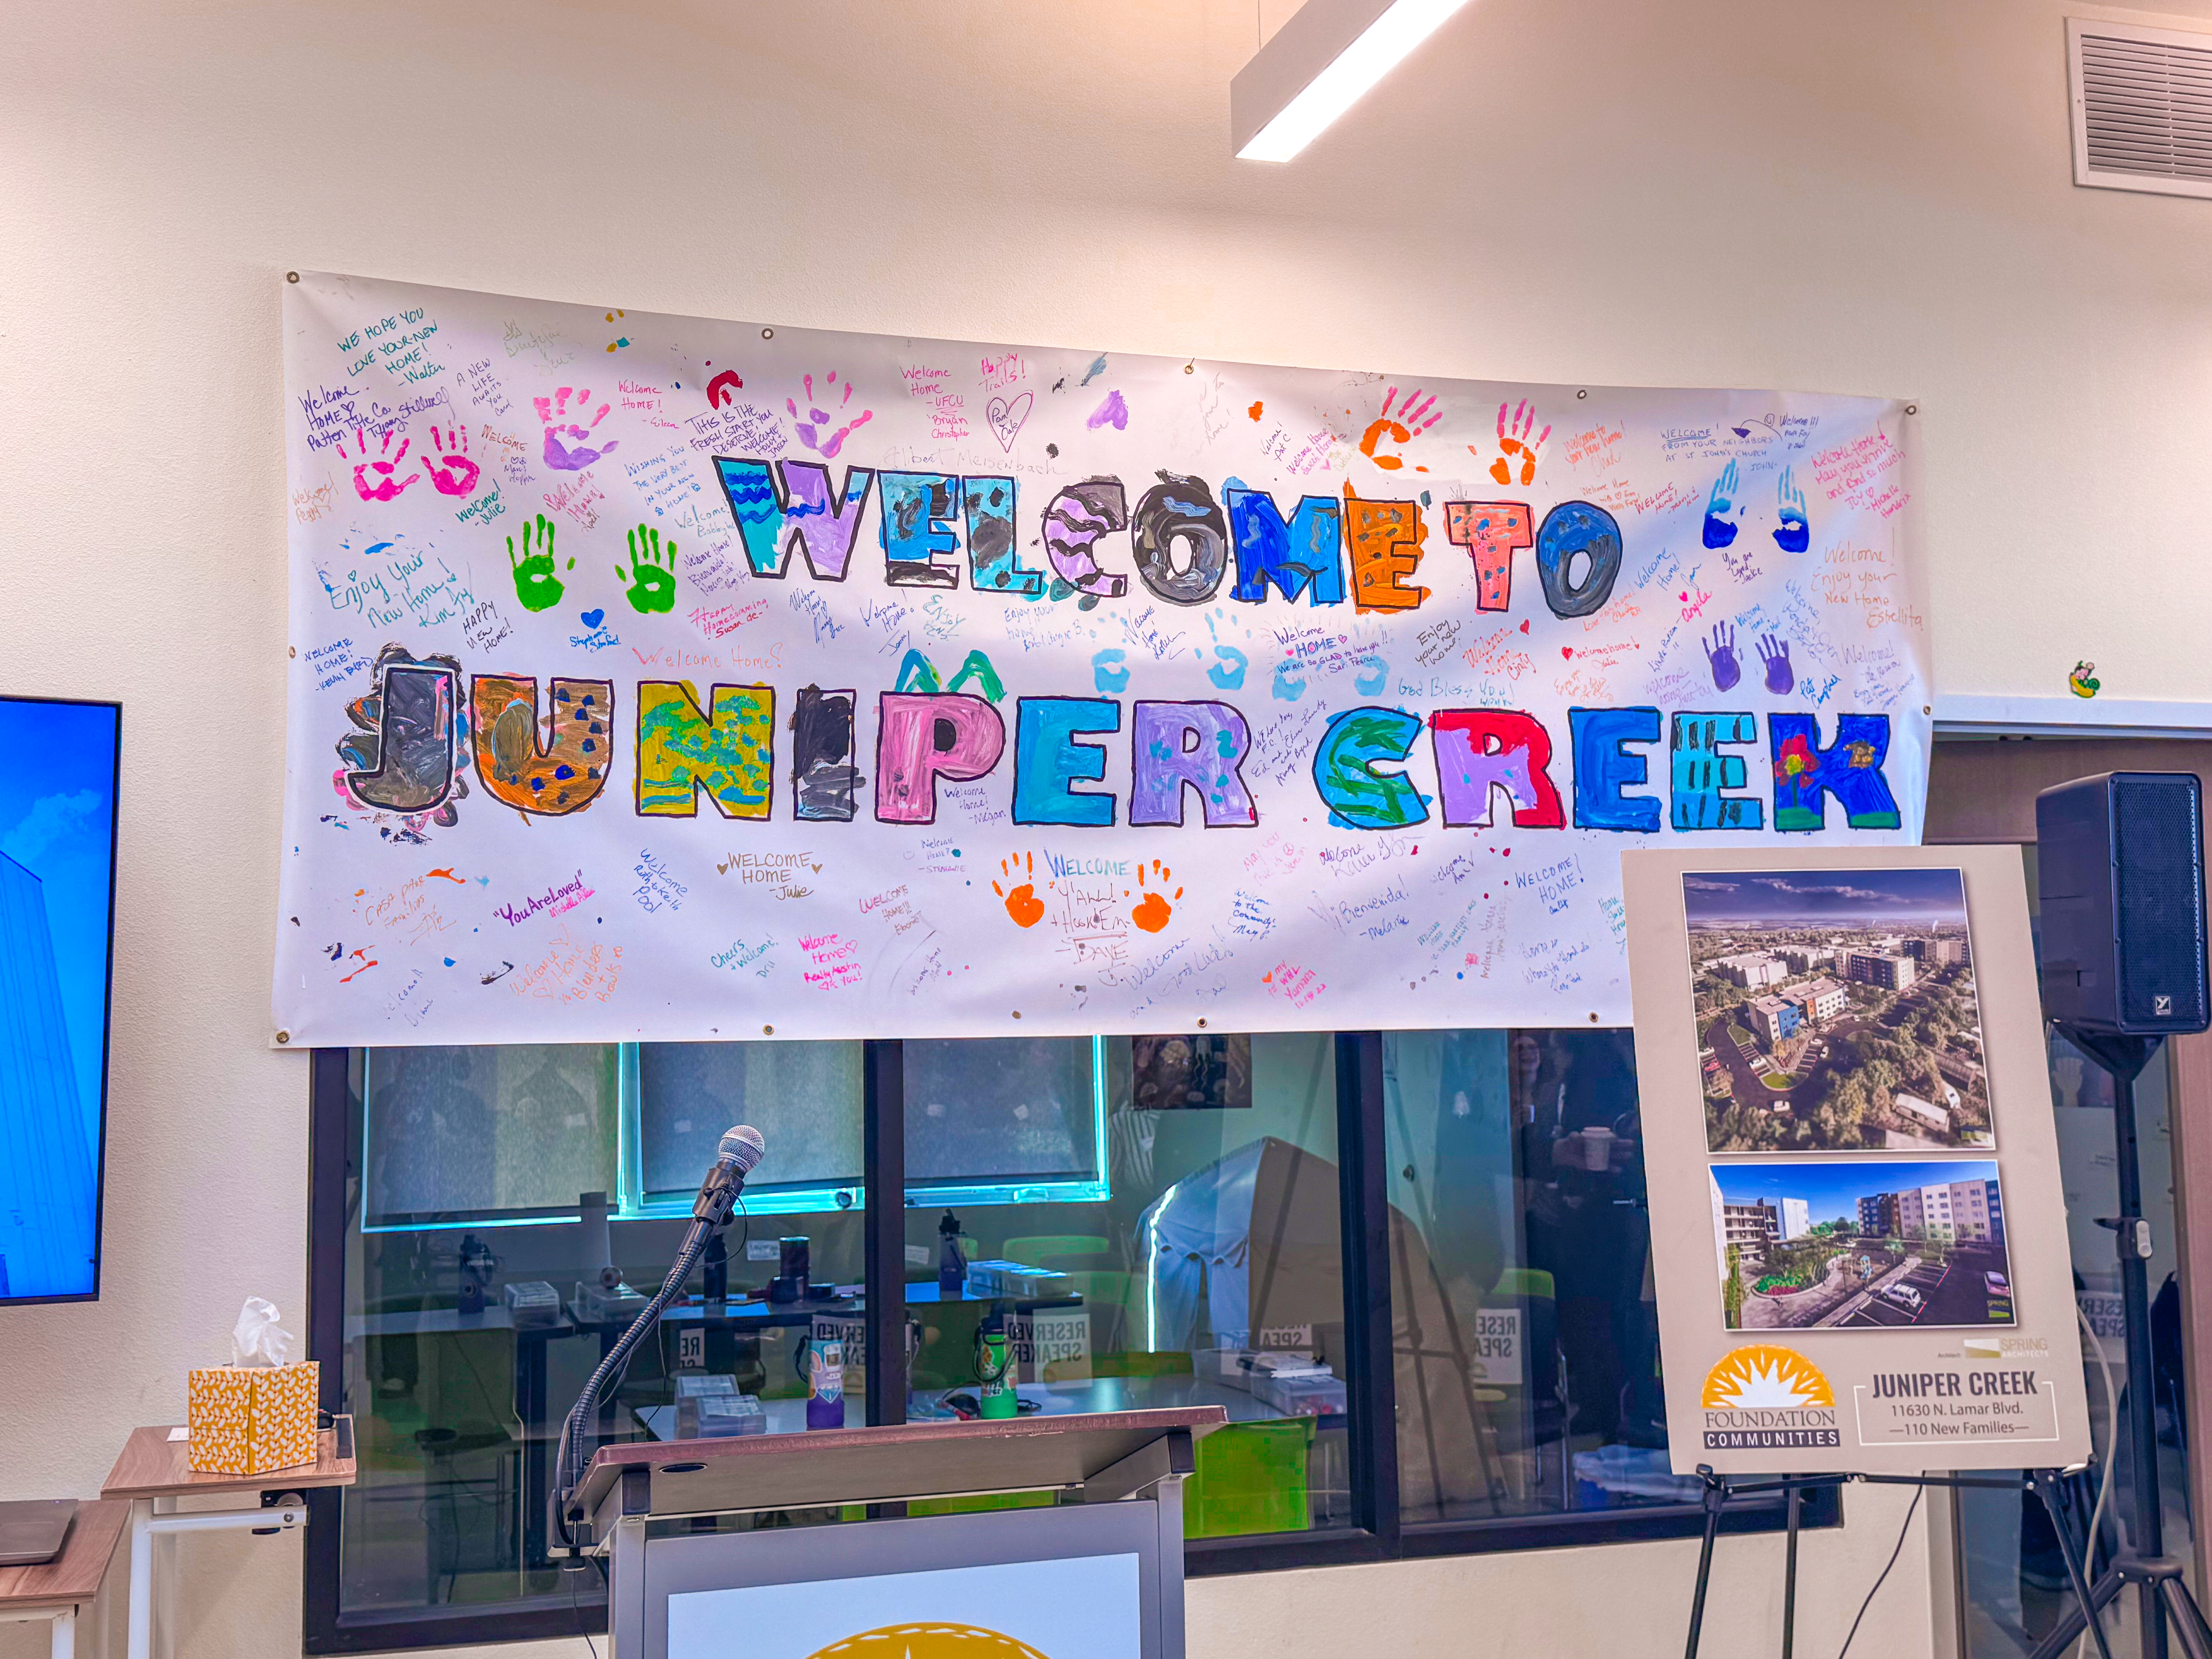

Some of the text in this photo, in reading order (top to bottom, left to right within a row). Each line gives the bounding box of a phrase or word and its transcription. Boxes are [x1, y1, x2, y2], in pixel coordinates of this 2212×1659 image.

[337, 307, 424, 352] WE HOPE YOU
[347, 350, 376, 376] LOVE
[385, 343, 432, 374] HOME!
[981, 353, 1018, 379] Happy
[457, 358, 491, 386] A NEW
[472, 373, 495, 392] LIFE
[900, 364, 951, 379] Welcome
[298, 385, 360, 413] Welcome
[472, 381, 501, 406] AWAITS
[619, 379, 662, 394] Welcome
[911, 383, 943, 396] Home
[485, 393, 503, 408] YOU
[621, 398, 663, 414] HOME!
[685, 404, 759, 435] THIS IS THE
[690, 410, 773, 451] FRESH START YOU
[932, 414, 967, 430] Bryan
[481, 424, 527, 451] WELCOME
[713, 426, 759, 455] DESERVE!
[741, 418, 785, 452] WELCOME!
[1662, 440, 1716, 452] FROM YOUR
[625, 454, 666, 477] WISHING
[882, 446, 955, 469] Albert
[1666, 453, 1677, 462] AT
[1877, 449, 1906, 474] much
[654, 482, 676, 498] YOUR
[675, 500, 730, 529] Welcome!
[711, 455, 1623, 618] WELCOME TO
[1825, 527, 1894, 567] Welcome!
[1635, 547, 1671, 589] Welcome
[1812, 567, 1897, 591] Enjoy your
[330, 550, 423, 614] Enjoy Your
[1825, 592, 1889, 606] New Home
[368, 608, 403, 629] New
[463, 601, 499, 634] HAPPY
[484, 618, 514, 653] HOME!
[1272, 627, 1325, 646] Welcome
[1415, 620, 1461, 668] your new
[1417, 619, 1450, 646] Enjoy
[632, 646, 721, 668] Welcome
[1295, 637, 1337, 659] HOME
[1278, 661, 1290, 674] We
[1291, 661, 1305, 671] are
[1319, 653, 1342, 665] GLAD
[345, 664, 1902, 831] JUNIPER CREEK
[945, 787, 986, 799] Welcome
[641, 848, 687, 897] Welcome
[728, 852, 813, 869] WELCOME
[1044, 847, 1130, 878] WELCOME
[742, 869, 792, 884] HOME
[859, 885, 908, 914] WELCOME
[711, 939, 745, 968] Cheers
[2001, 1338, 2048, 1351] SPRING
[1873, 1371, 2038, 1399] JUNIPER CREEK
[1705, 1409, 1836, 1428] FOUNDATION
[1891, 1401, 2024, 1417] 11630 N. Lamar Blvd.
[1707, 1429, 1838, 1447] COMMUNITIES
[1931, 1422, 1959, 1435] New
